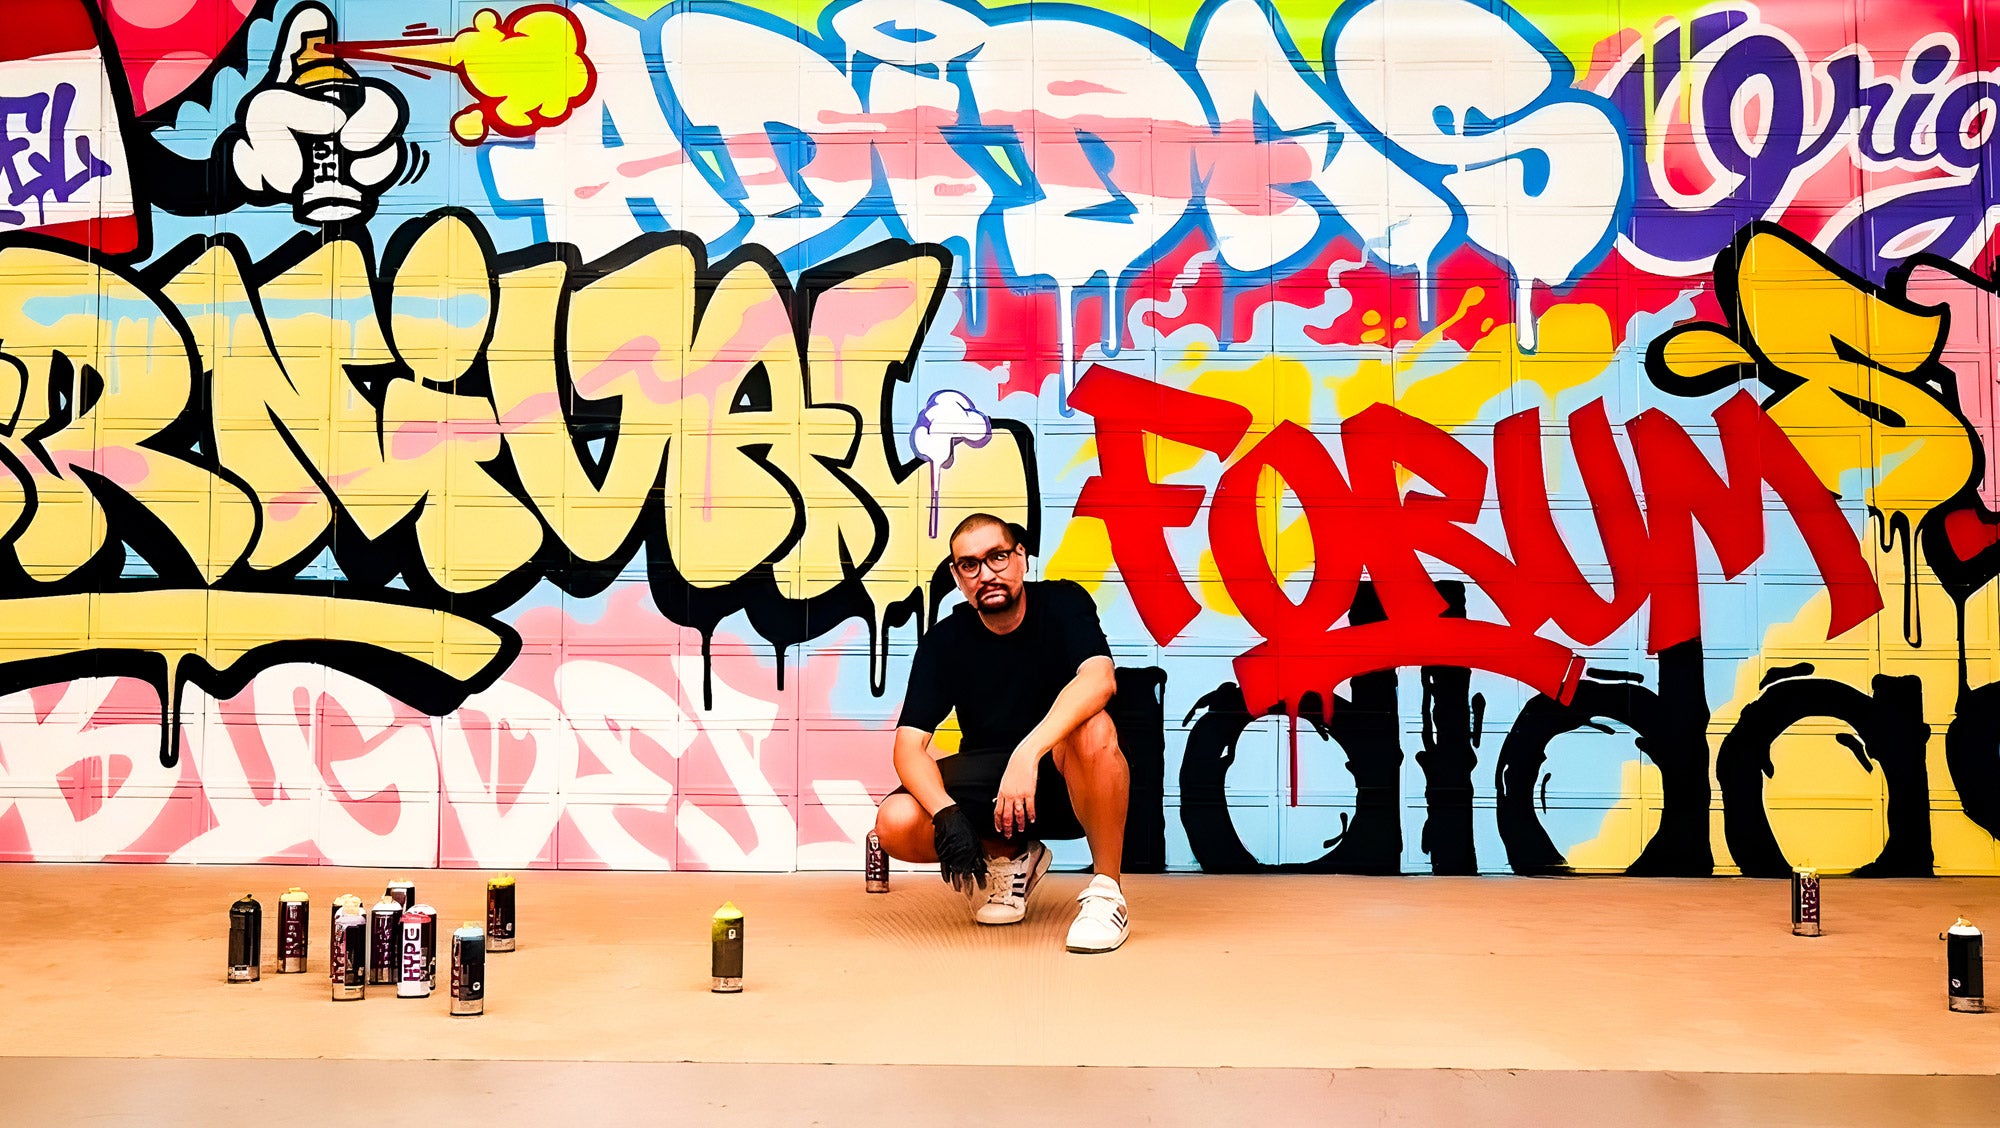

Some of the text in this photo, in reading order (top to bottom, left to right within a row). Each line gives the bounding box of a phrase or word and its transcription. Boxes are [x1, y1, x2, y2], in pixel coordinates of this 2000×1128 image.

[1066, 363, 1885, 656] FORUM
[1085, 575, 2000, 878] dida
[403, 927, 421, 982] HYPE
